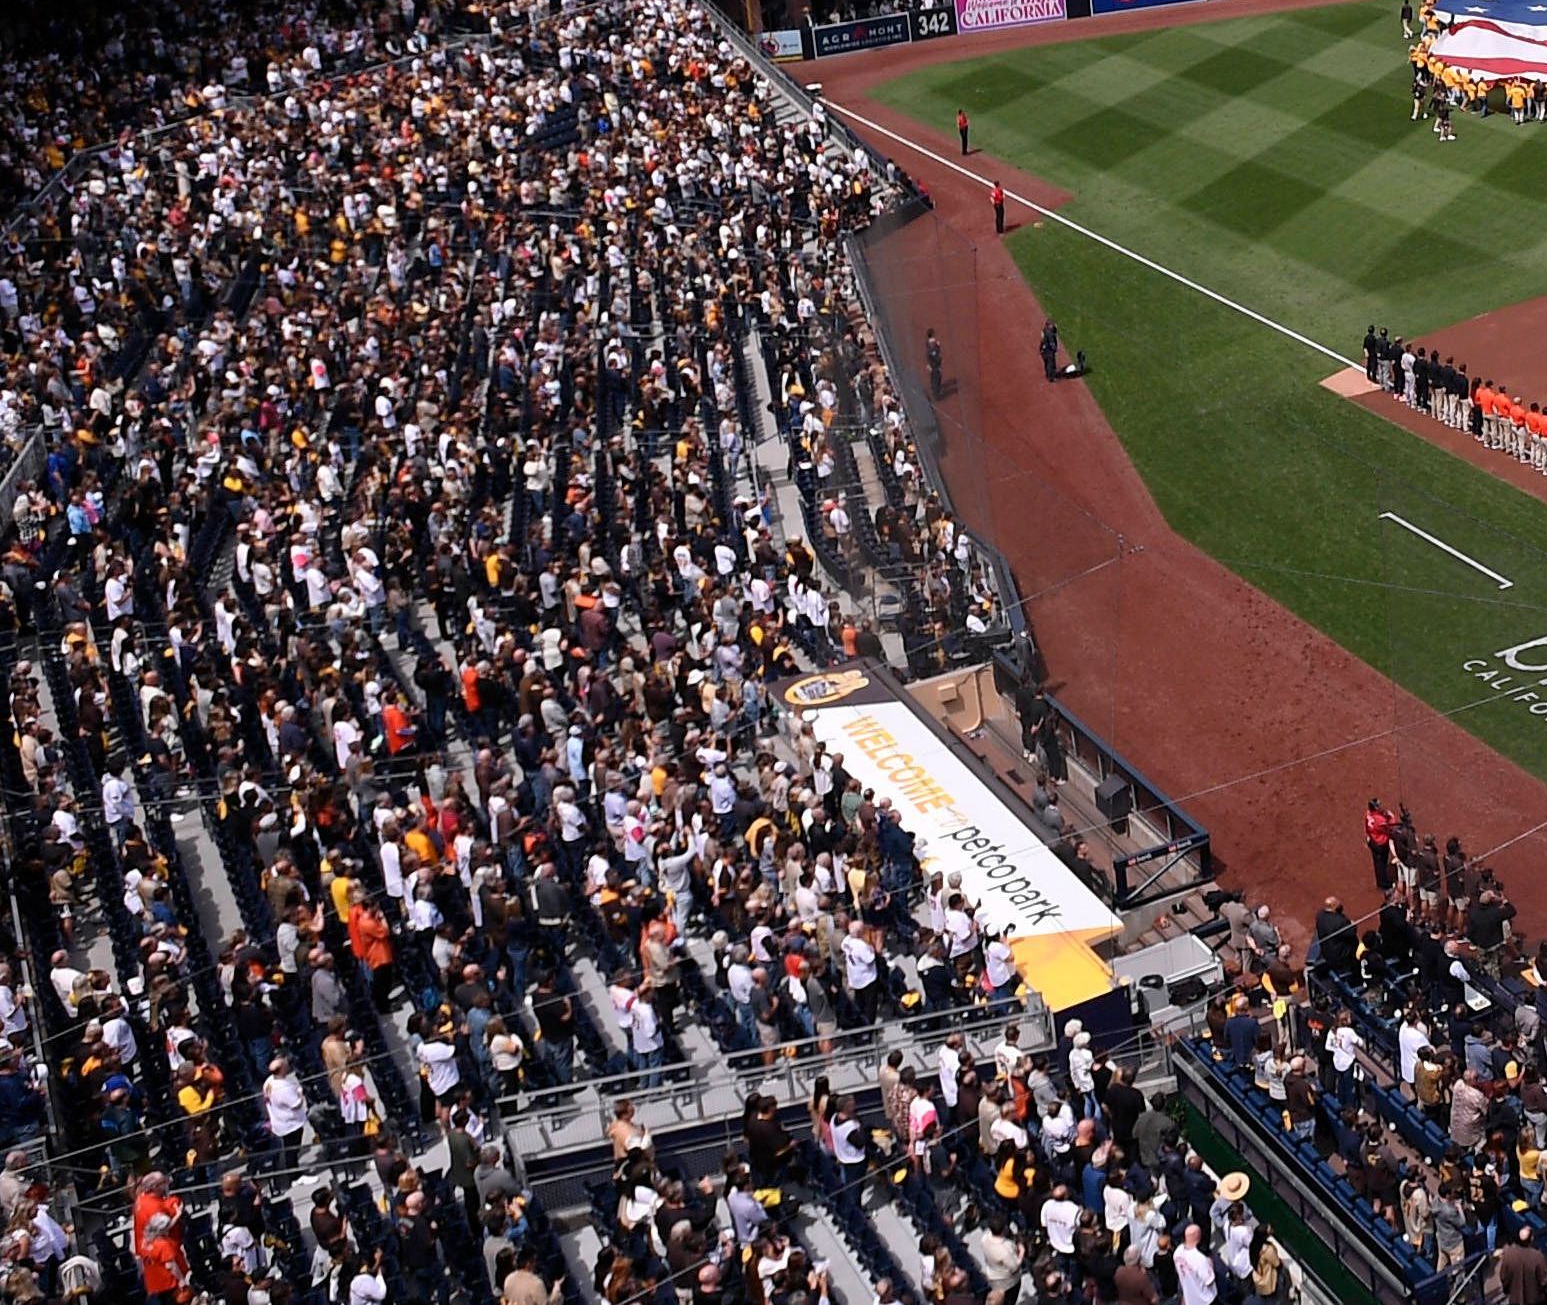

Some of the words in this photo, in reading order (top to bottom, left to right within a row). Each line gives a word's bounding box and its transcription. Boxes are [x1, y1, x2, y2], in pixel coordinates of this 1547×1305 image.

[918, 12, 950, 36] 342
[960, 0, 1061, 28] CALIFORNIA
[840, 714, 955, 814] WELCOME
[938, 824, 1017, 880] petco
[996, 875, 1062, 926] park
